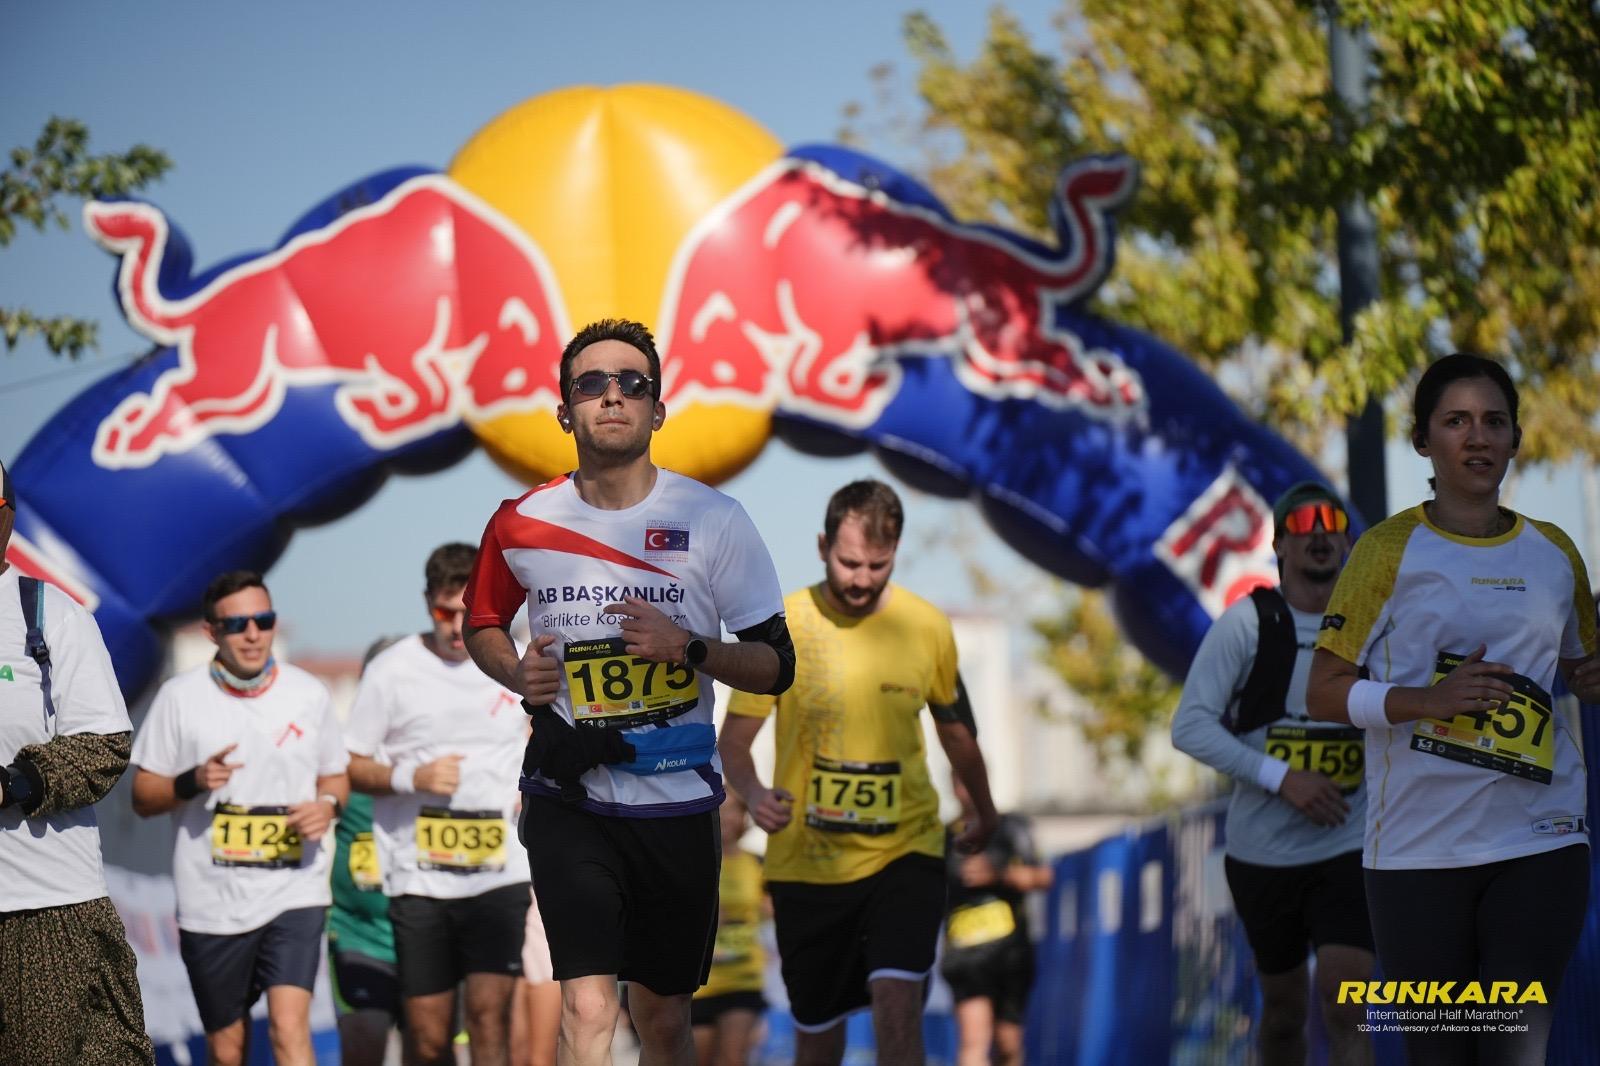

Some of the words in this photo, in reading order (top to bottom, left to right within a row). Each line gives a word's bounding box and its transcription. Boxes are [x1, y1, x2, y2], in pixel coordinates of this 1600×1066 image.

[538, 588, 557, 604] AB
[563, 583, 685, 606] BAŞKANLIĞI
[568, 643, 611, 653] RUNKARA
[572, 660, 695, 702] 1875
[811, 776, 894, 808] 1751
[423, 824, 503, 849] 1033
